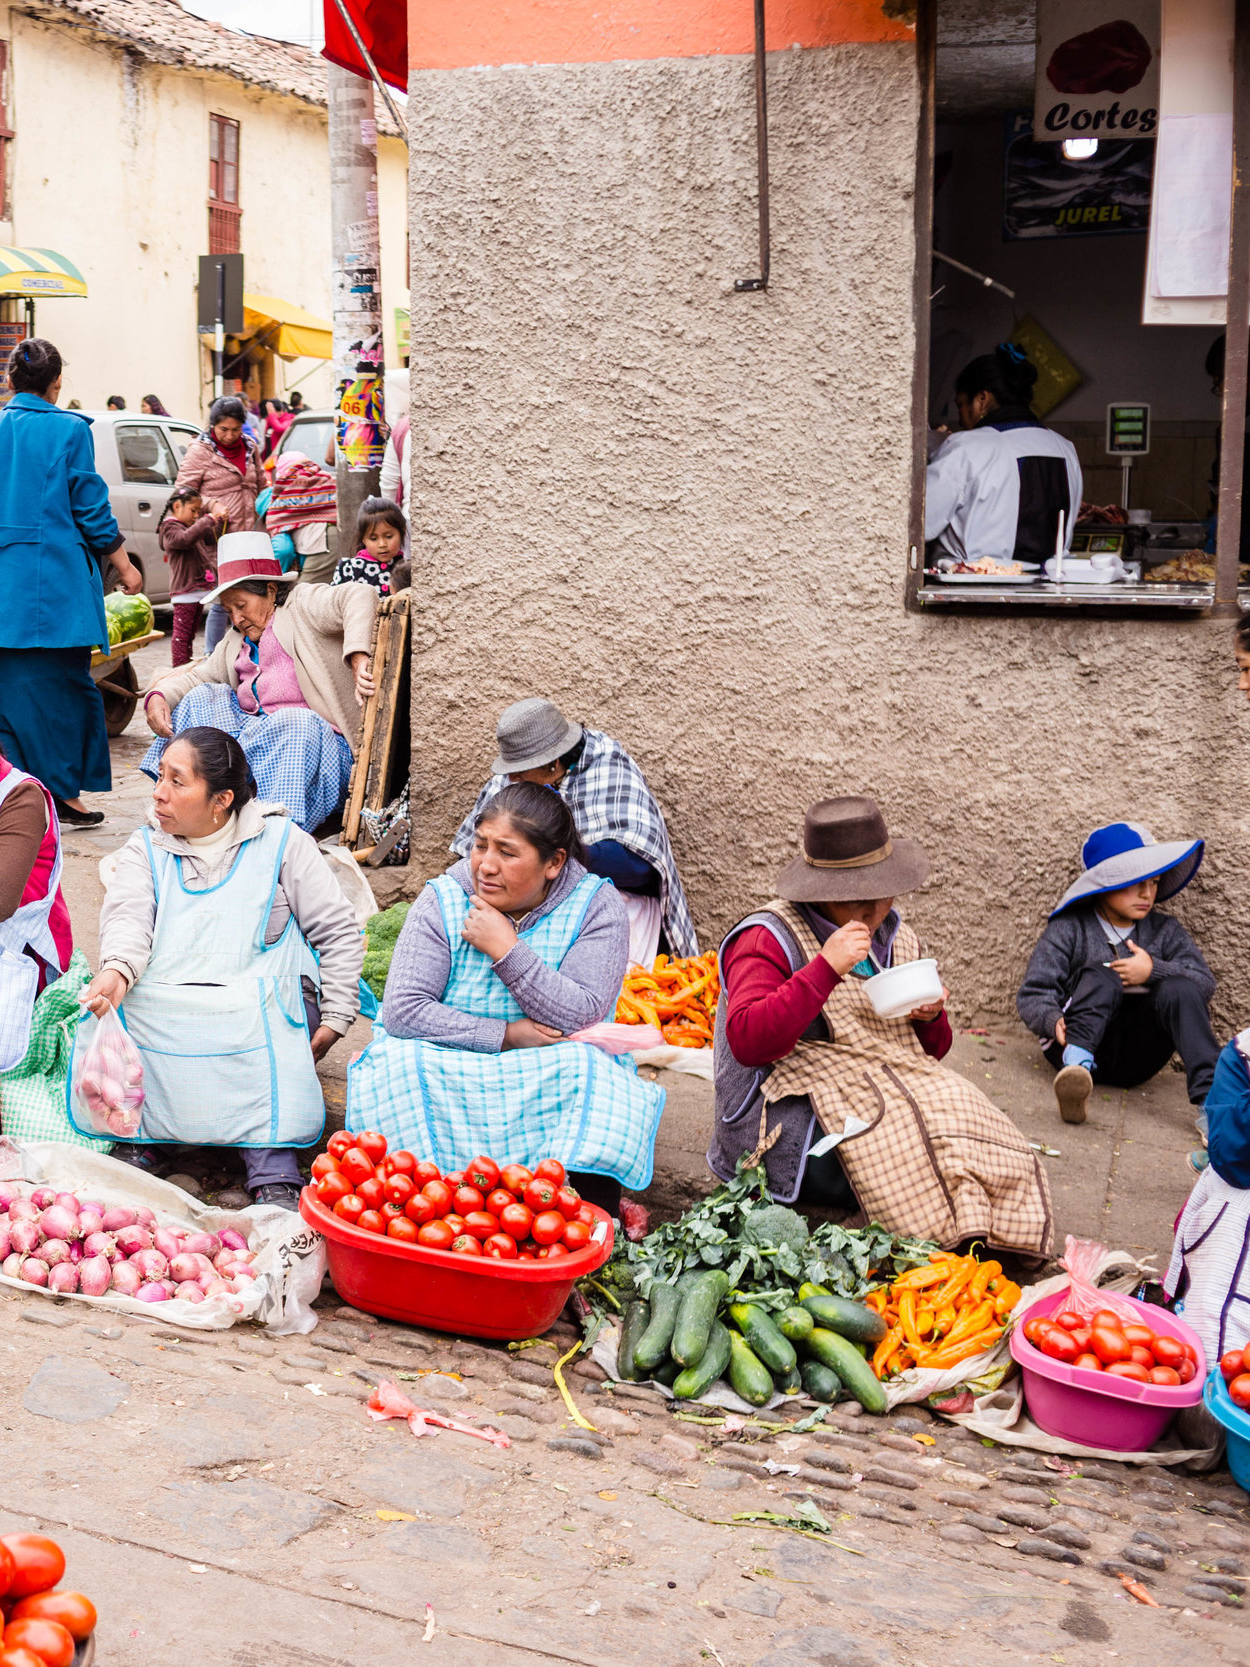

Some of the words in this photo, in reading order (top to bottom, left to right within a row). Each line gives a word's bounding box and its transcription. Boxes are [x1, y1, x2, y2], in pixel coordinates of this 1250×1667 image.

[1045, 102, 1157, 133] Cortes
[1055, 206, 1122, 225] JUREL
[343, 402, 361, 415] 06
